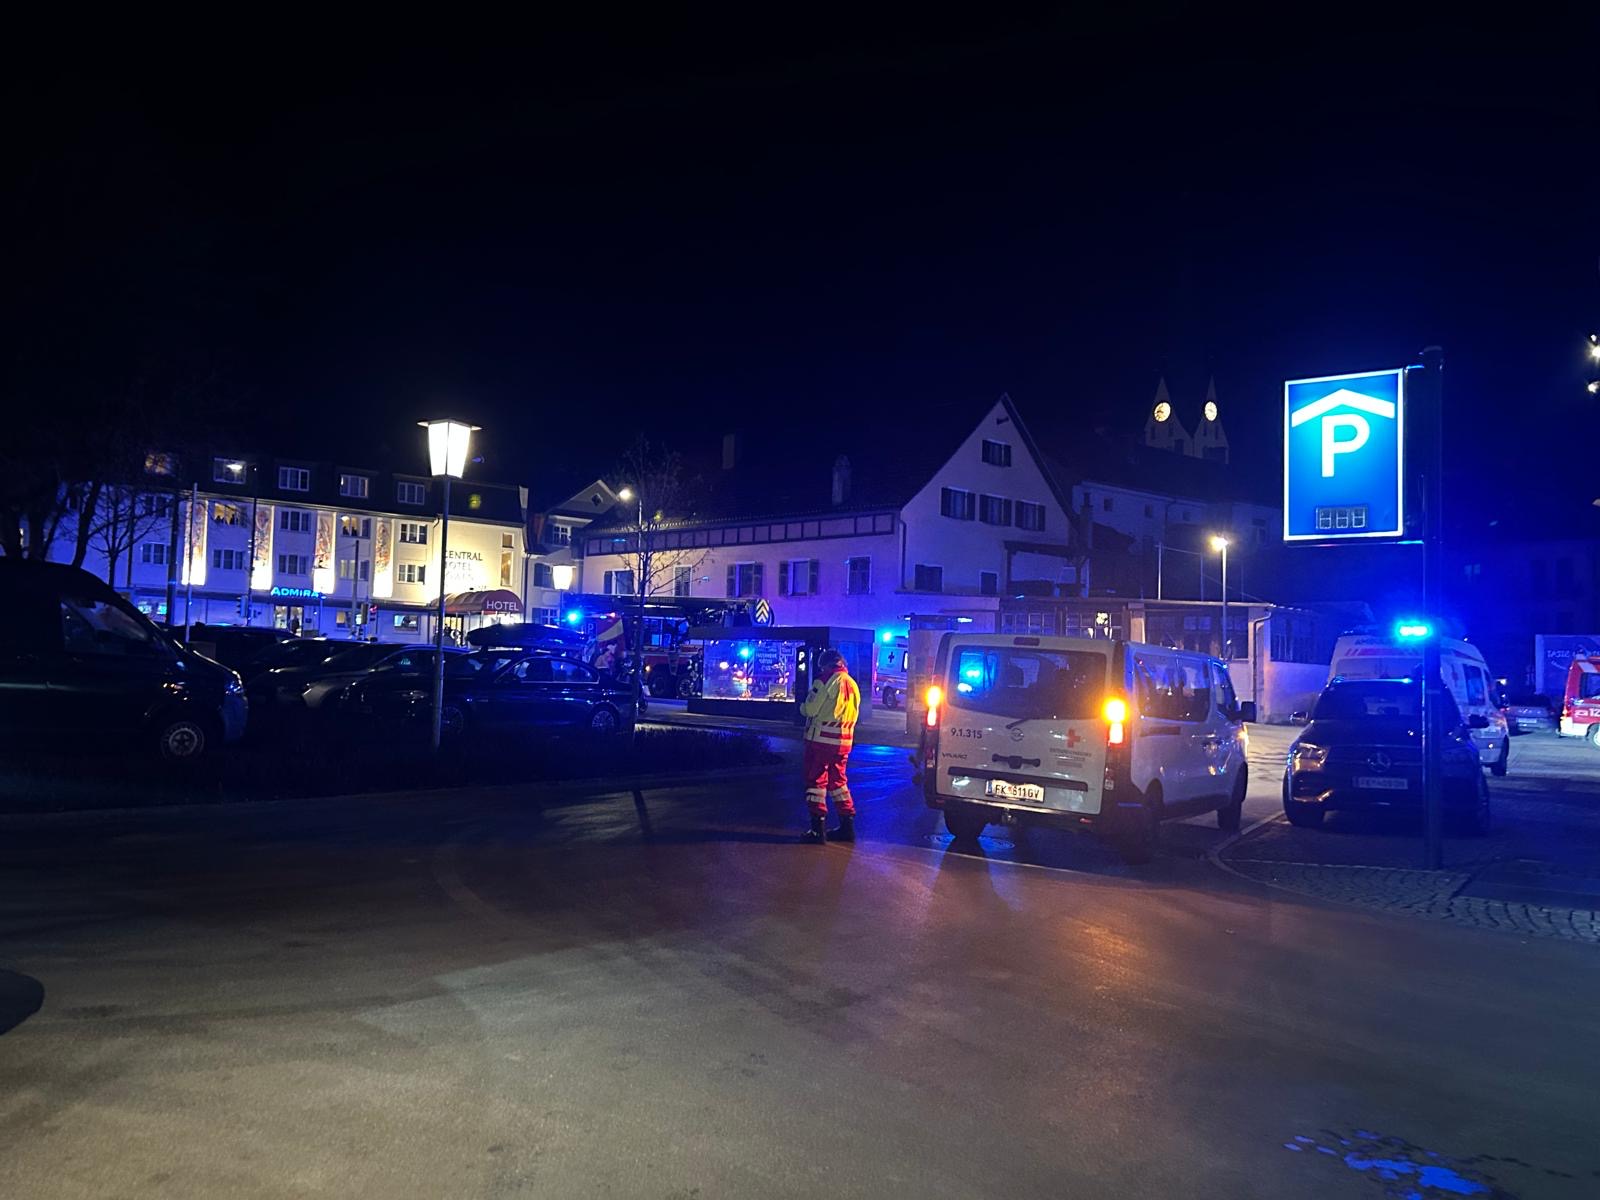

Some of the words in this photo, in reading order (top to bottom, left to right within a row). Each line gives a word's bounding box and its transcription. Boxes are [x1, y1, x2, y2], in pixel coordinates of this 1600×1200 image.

[1321, 413, 1371, 478] P
[445, 561, 472, 571] OTEL
[270, 586, 319, 598] ADMIRA
[486, 600, 519, 611] HOTEL
[950, 727, 983, 739] 9.1.315
[995, 784, 1007, 795] FK
